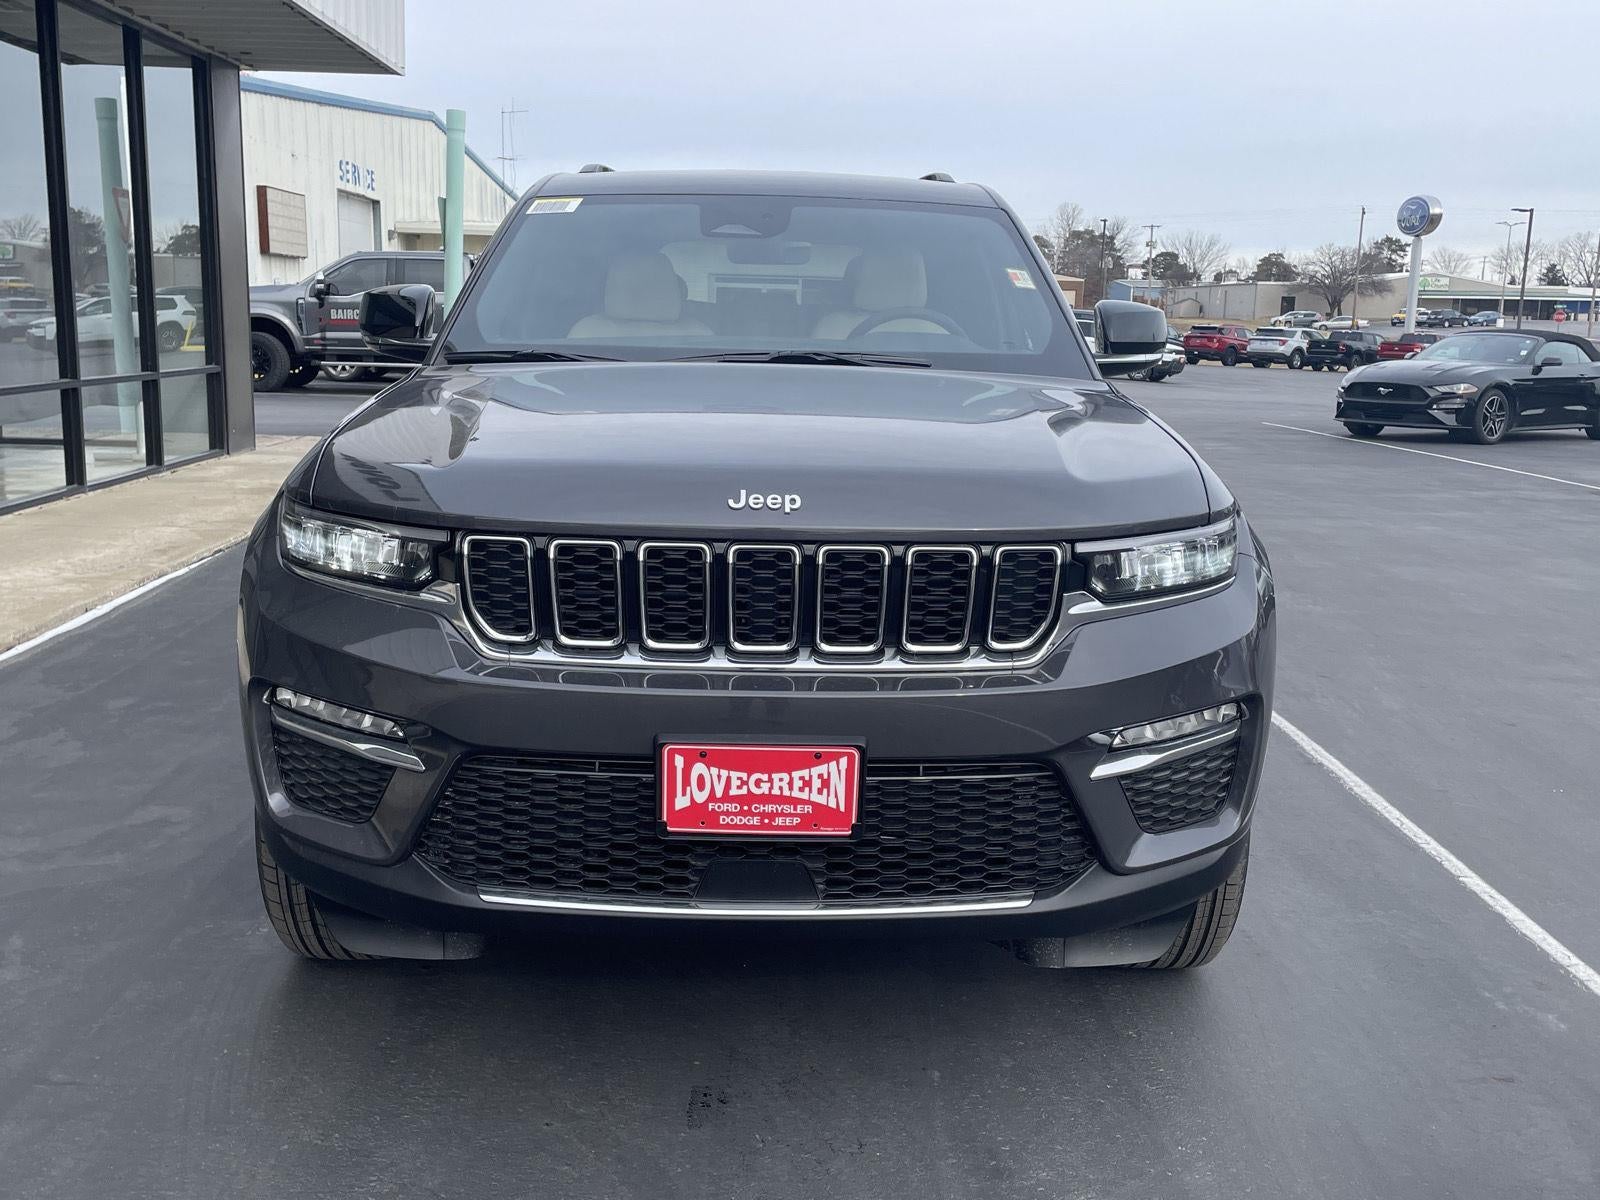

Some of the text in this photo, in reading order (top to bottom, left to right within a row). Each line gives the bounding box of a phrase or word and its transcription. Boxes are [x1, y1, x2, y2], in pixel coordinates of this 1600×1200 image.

[727, 489, 802, 514] Jeep
[674, 753, 848, 813] LOVEGREEN
[708, 803, 813, 814] FORD CHRYSLER
[719, 816, 801, 826] DODGE JEEP
